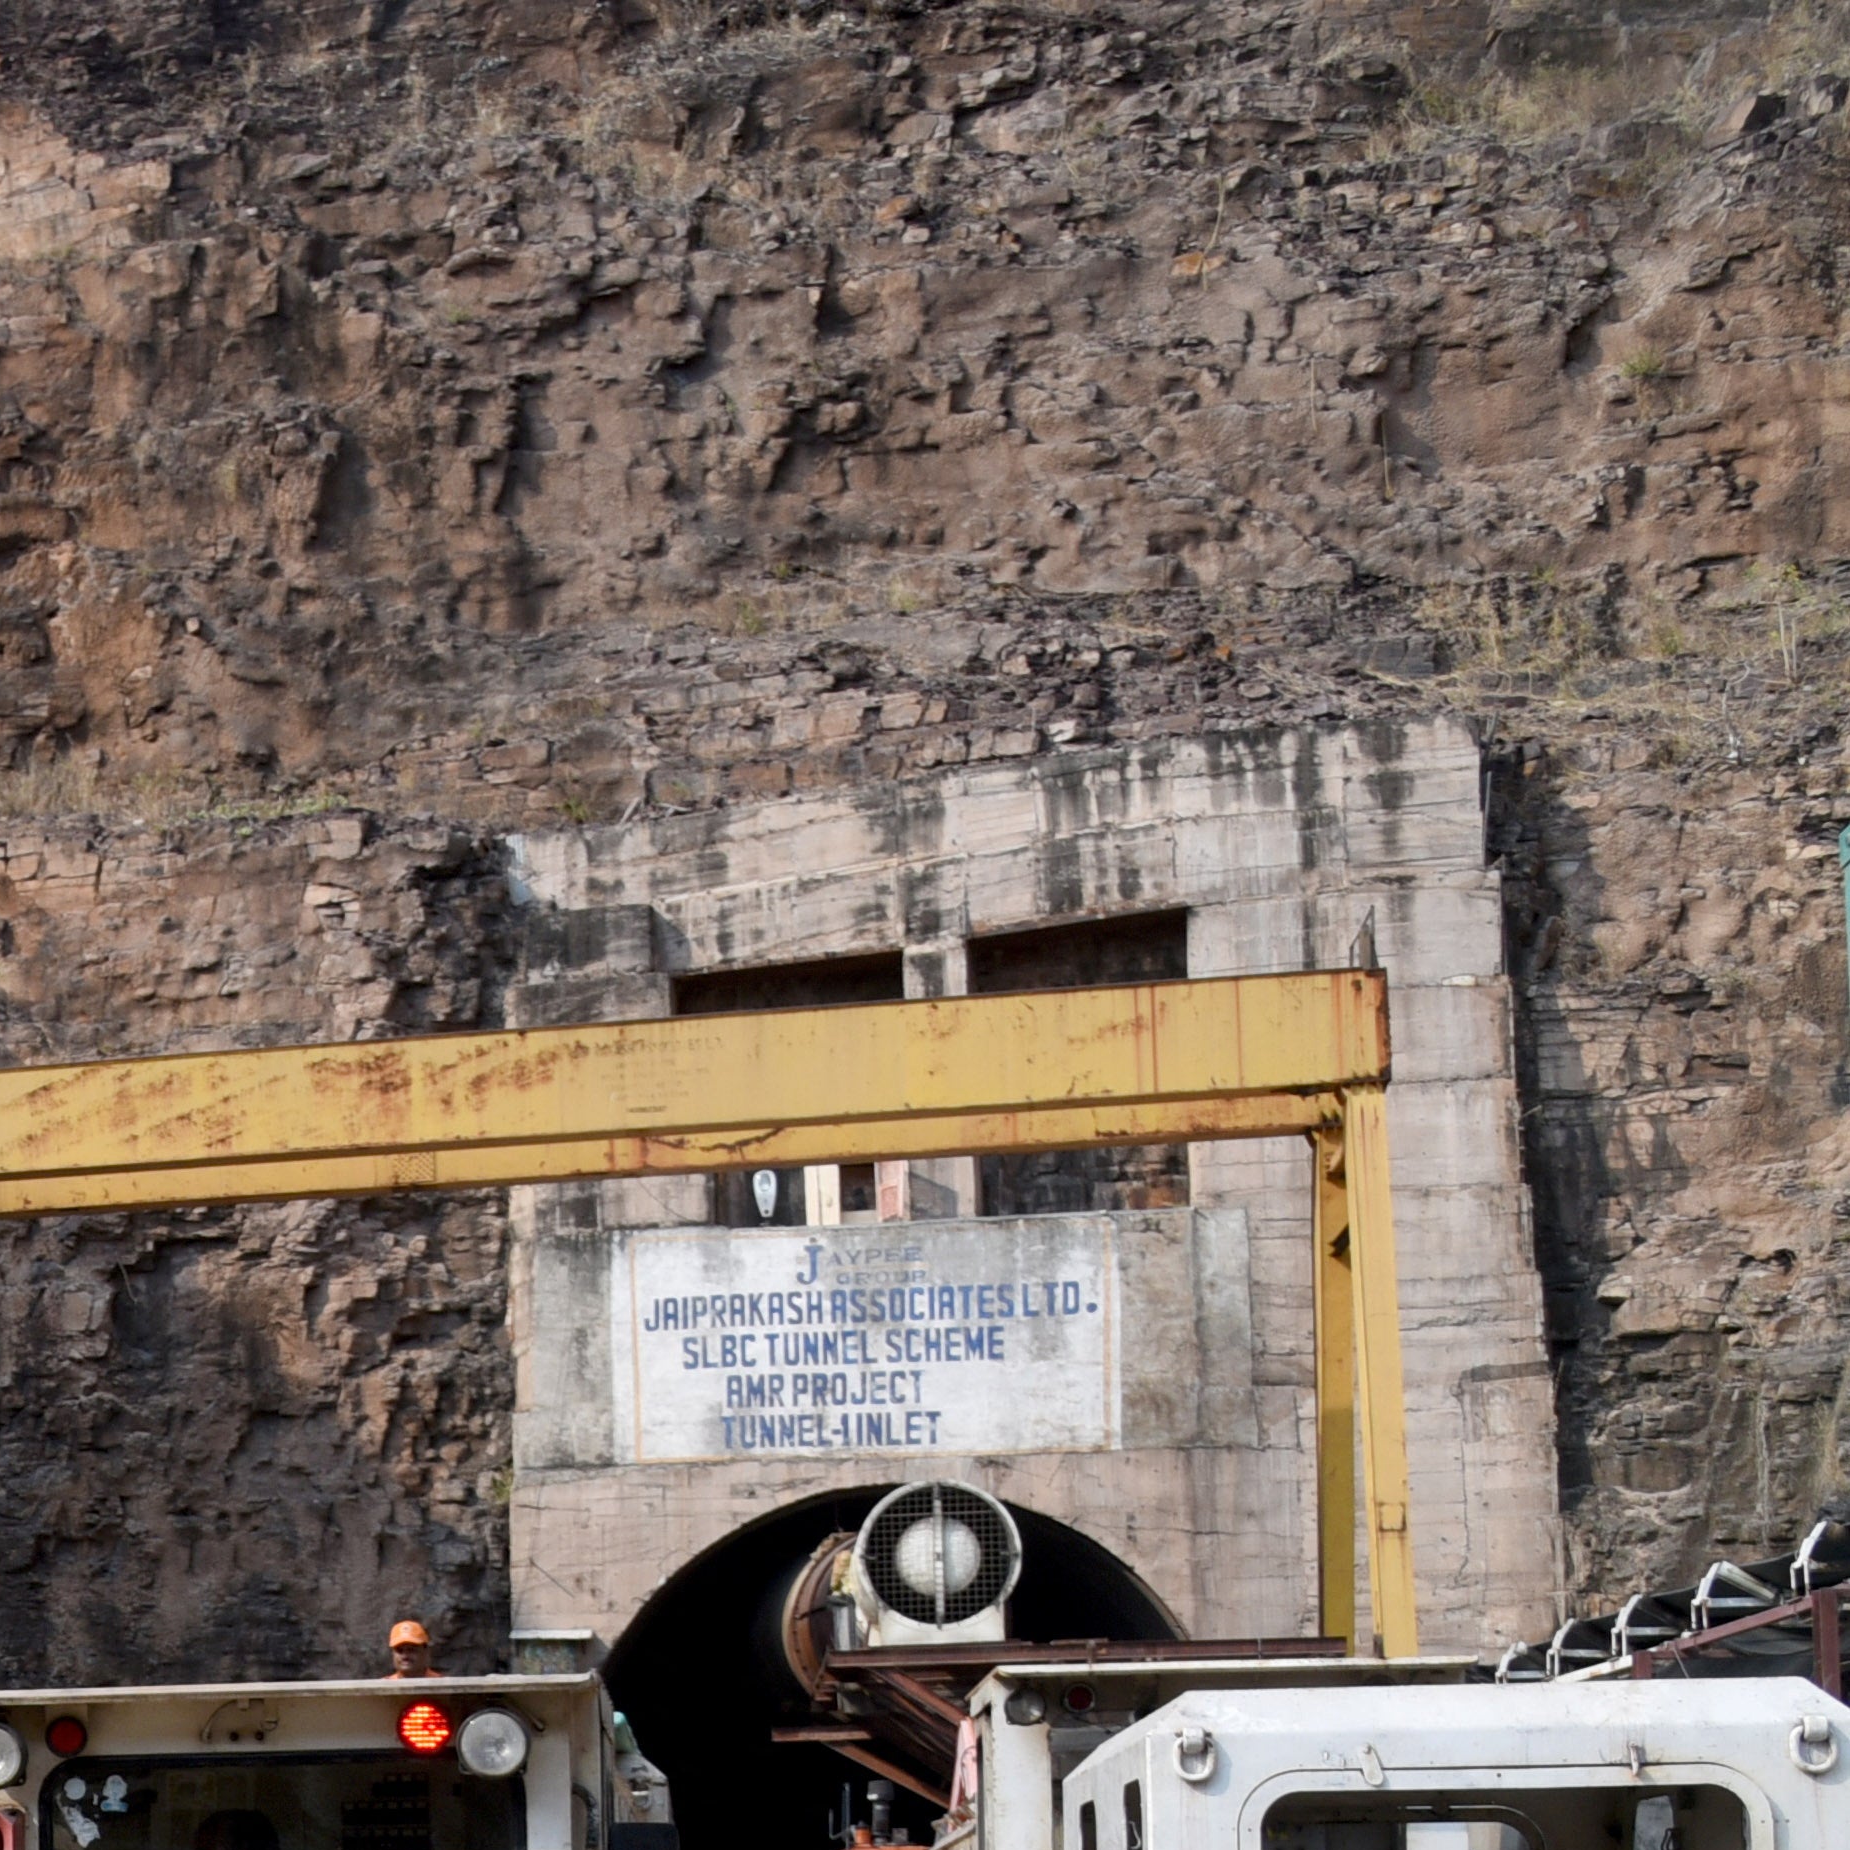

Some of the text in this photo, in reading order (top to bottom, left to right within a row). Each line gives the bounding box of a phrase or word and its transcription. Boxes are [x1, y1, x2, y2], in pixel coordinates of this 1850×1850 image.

[797, 1241, 924, 1285] JAYPEE
[836, 1270, 927, 1286] GROUP
[644, 1281, 1098, 1332] JAIPRAKASH ASSOCIATES LTD.
[683, 1326, 1005, 1369] SLBC TUNNEL SCHEME
[727, 1370, 925, 1407] AMR PROJECT
[720, 1411, 942, 1449] TUNNEL-1 INLET
